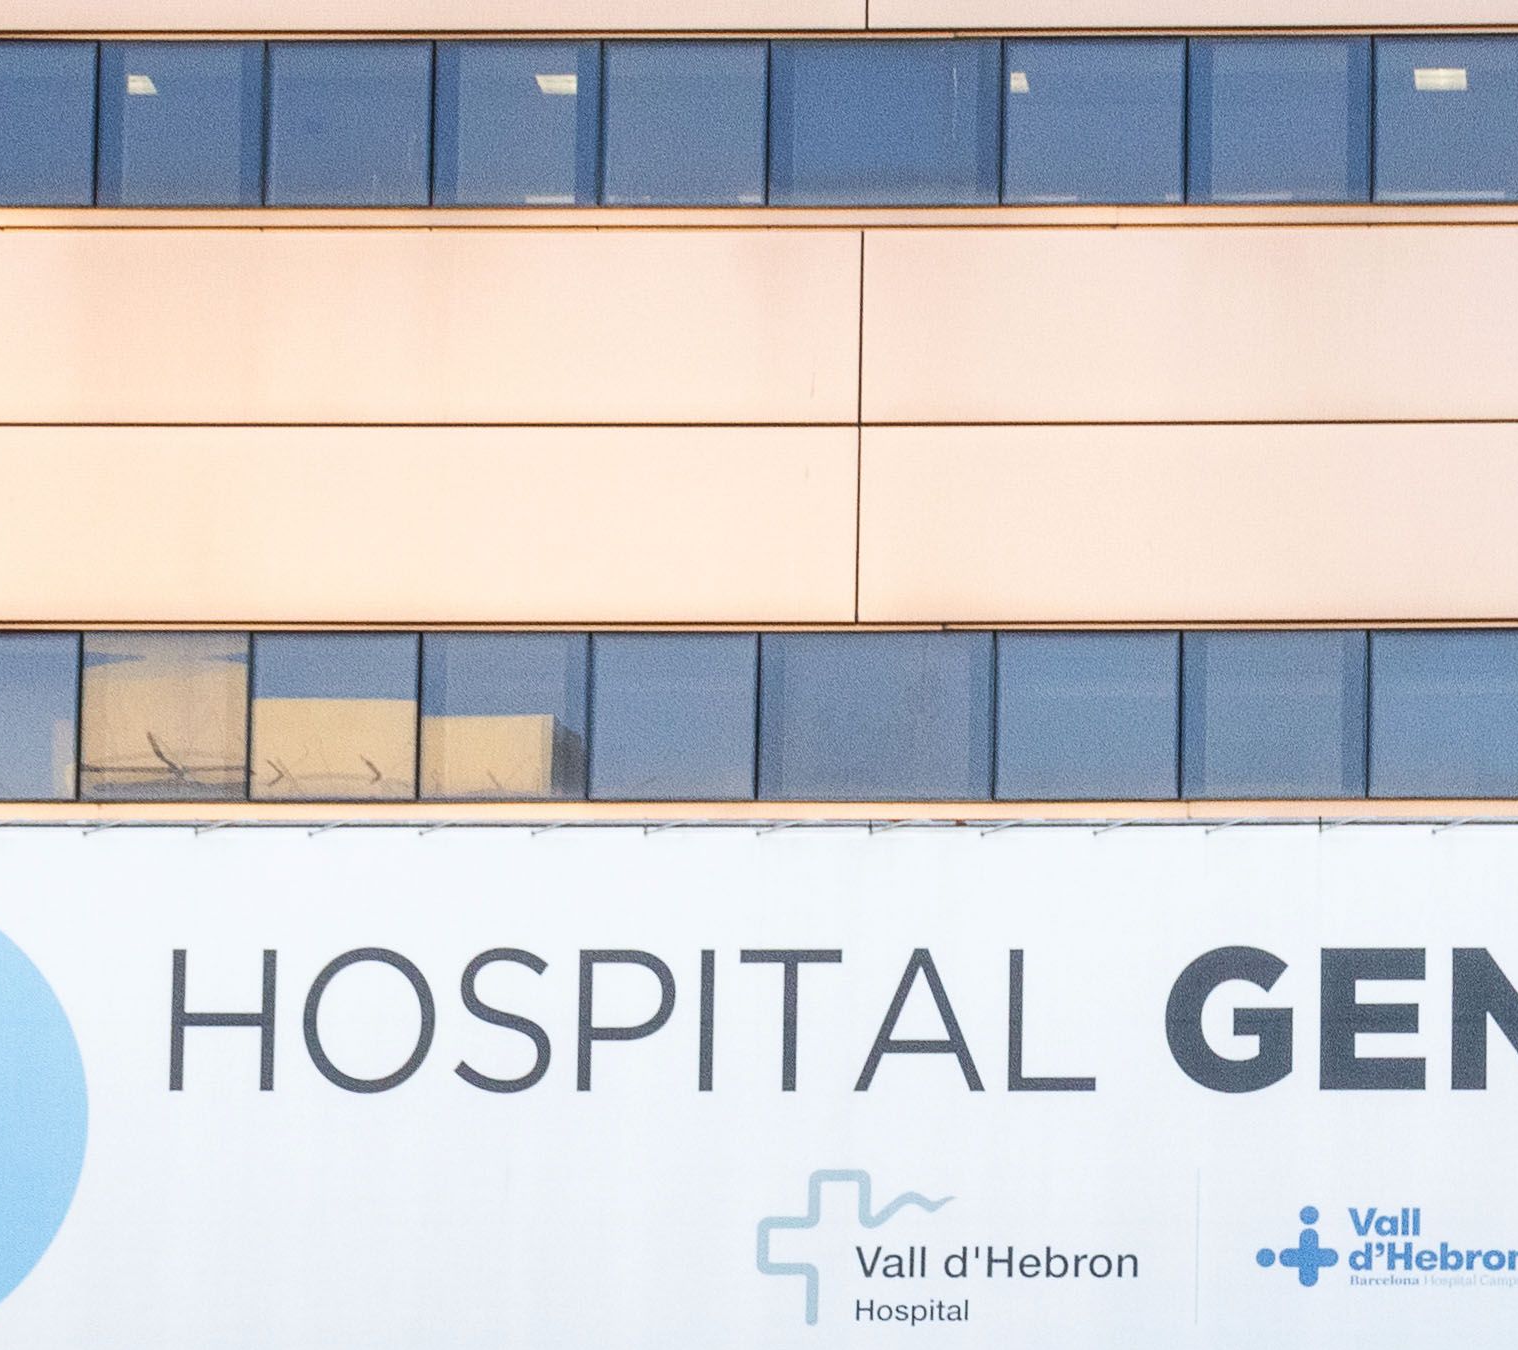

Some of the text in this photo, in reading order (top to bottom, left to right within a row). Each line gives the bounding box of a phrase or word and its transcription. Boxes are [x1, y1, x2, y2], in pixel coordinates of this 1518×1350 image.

[168, 946, 1097, 1094] HOSPITAL
[1348, 1207, 1421, 1237] Vall
[855, 1245, 1139, 1279] Vall d'Hebron
[1349, 1274, 1420, 1287] Barcelona
[1423, 1273, 1477, 1288] Hospital
[855, 1299, 970, 1327] Hospital
